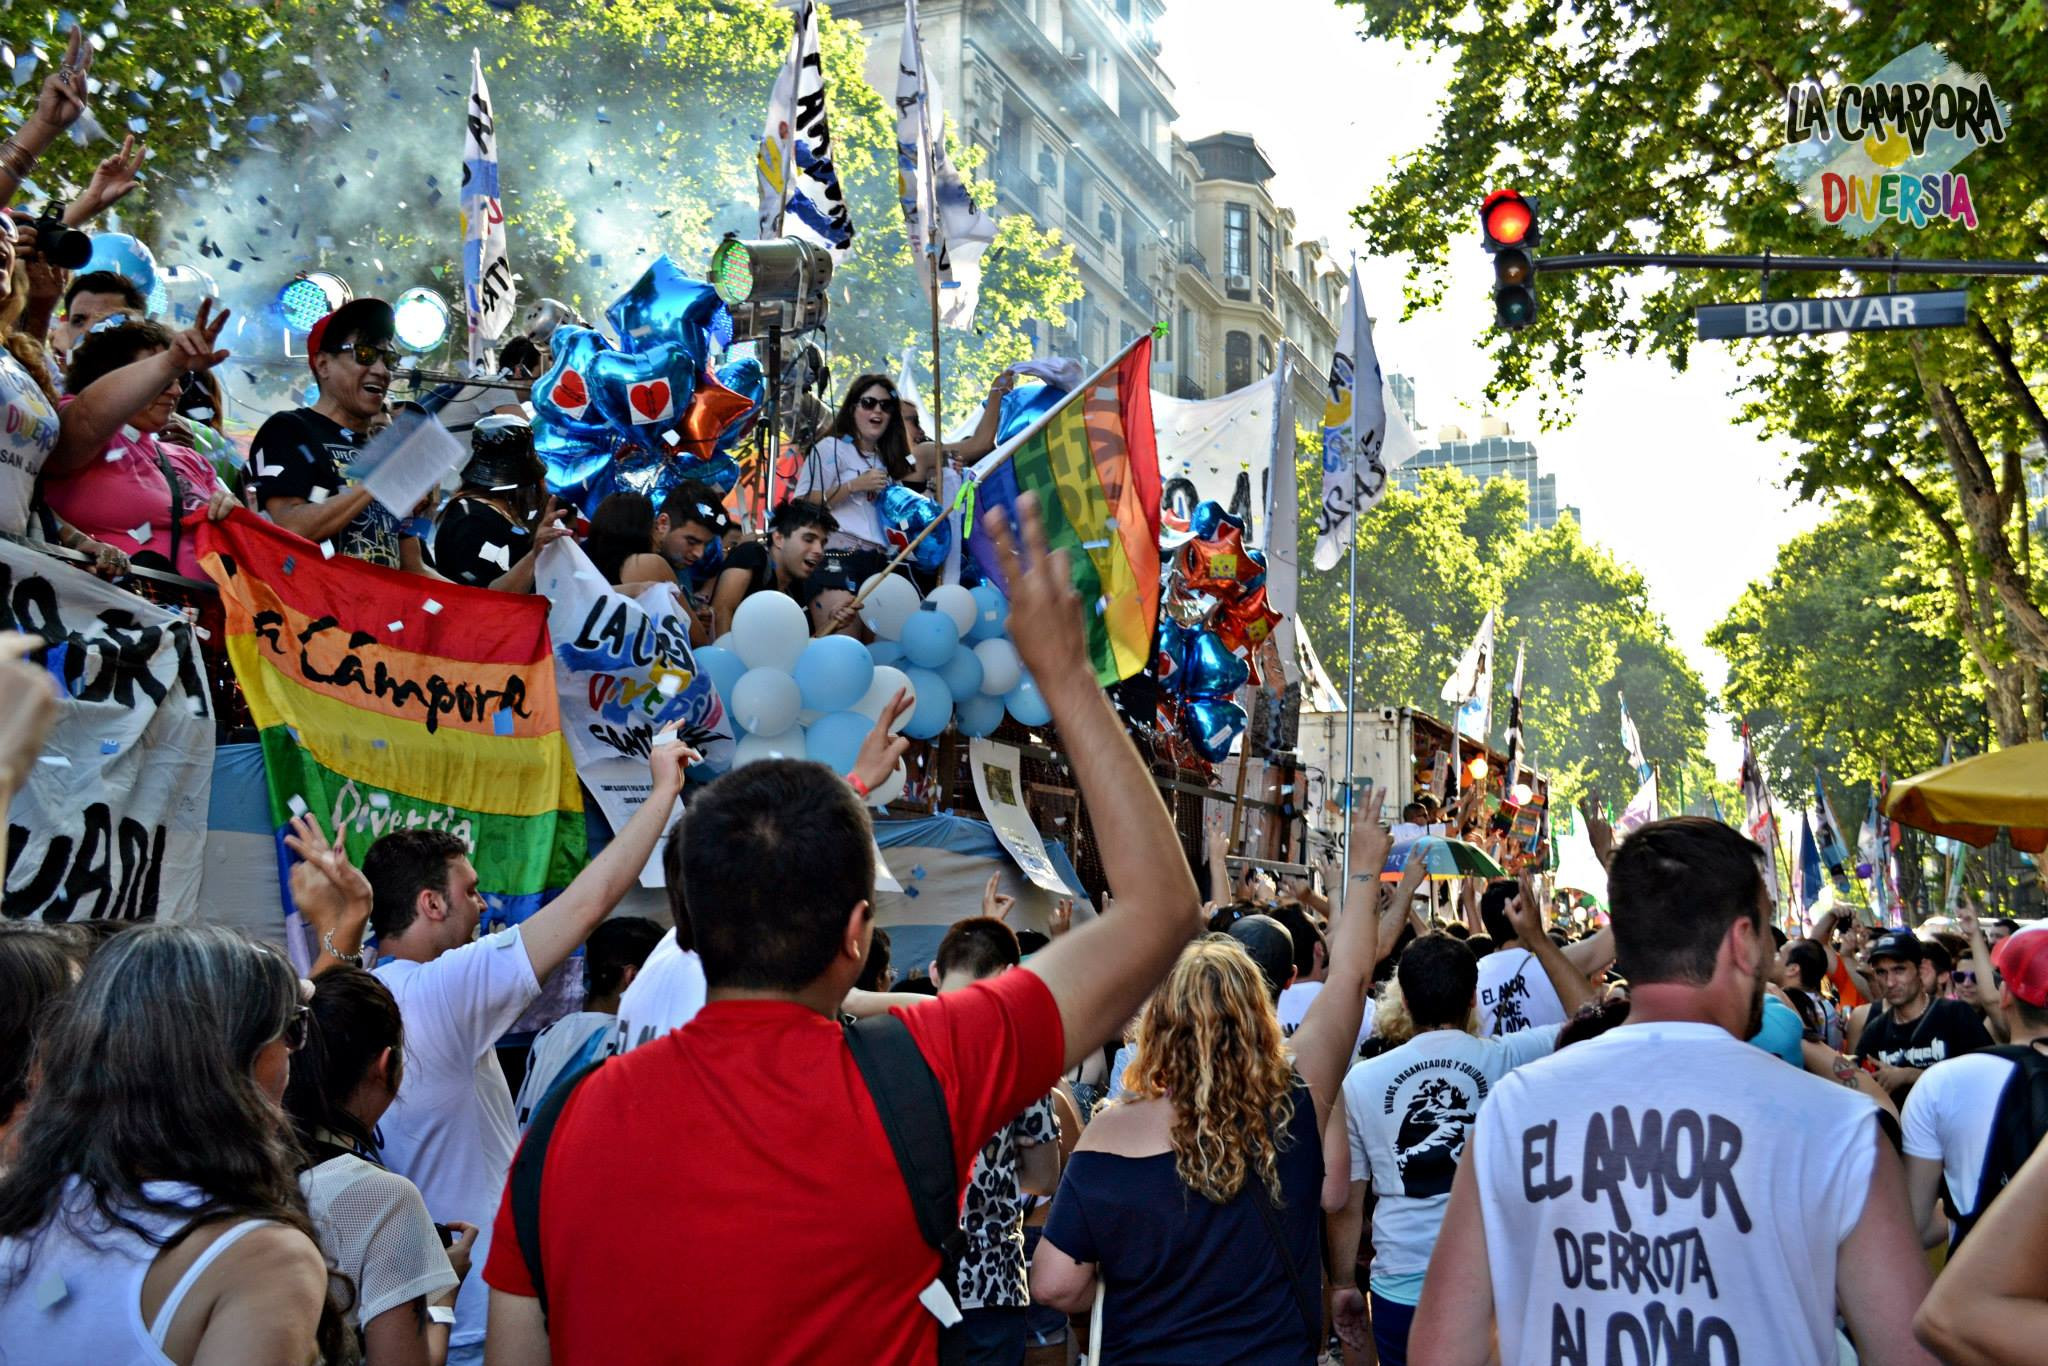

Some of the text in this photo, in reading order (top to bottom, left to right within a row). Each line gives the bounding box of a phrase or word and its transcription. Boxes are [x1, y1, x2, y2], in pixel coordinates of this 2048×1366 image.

[1745, 297, 1916, 333] BOLIVAR
[573, 594, 627, 656] LA
[1481, 973, 1531, 1006] EL AMOR
[1393, 1058, 1453, 1086] ORGANIZADOS
[1453, 1060, 1462, 1071] Y
[1522, 1104, 1753, 1234] EL AMOR
[1553, 1226, 1719, 1300] DERROTA
